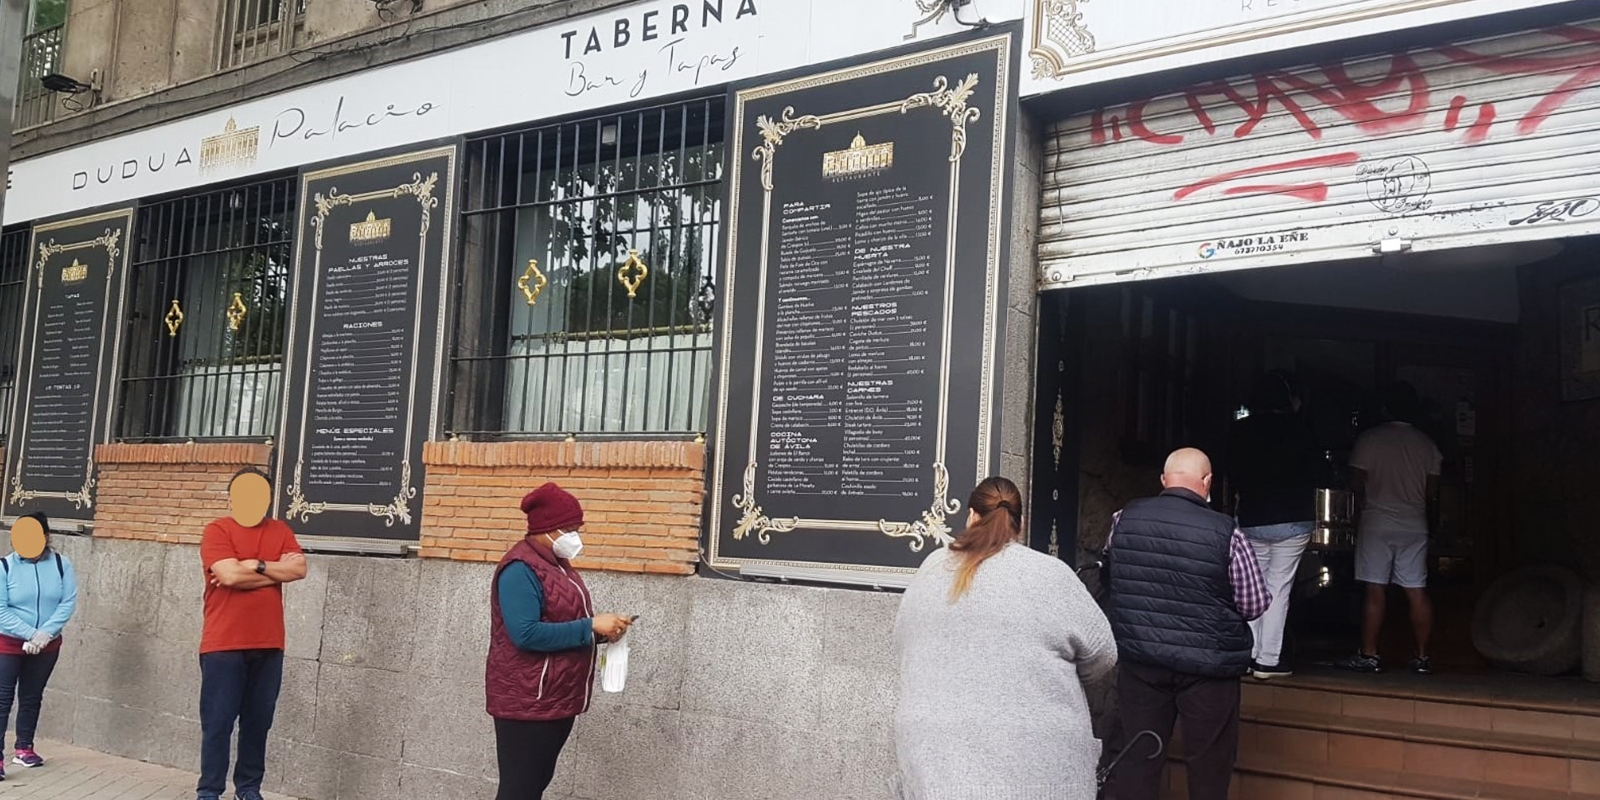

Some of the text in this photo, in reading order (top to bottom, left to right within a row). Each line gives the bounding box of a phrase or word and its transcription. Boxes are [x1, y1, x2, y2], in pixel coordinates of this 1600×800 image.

[561, 0, 757, 59] TABERNA
[565, 37, 746, 98] Bar y Tapas
[72, 96, 441, 190] DUDUA Palacio
[783, 203, 831, 215] COMPARTIR
[1257, 236, 1275, 244] LA
[1280, 231, 1309, 243] EÑE
[870, 243, 911, 252] NUESTRA
[348, 253, 388, 264] NUESTRAS
[853, 251, 888, 260] HUERTA
[328, 264, 362, 273] PAELLAS
[373, 258, 409, 268] ARROCES
[851, 302, 897, 310] NUESTROS
[851, 308, 897, 316] PESCADOS
[343, 321, 383, 329] RACIONES
[343, 426, 395, 434] ESPECIALES
